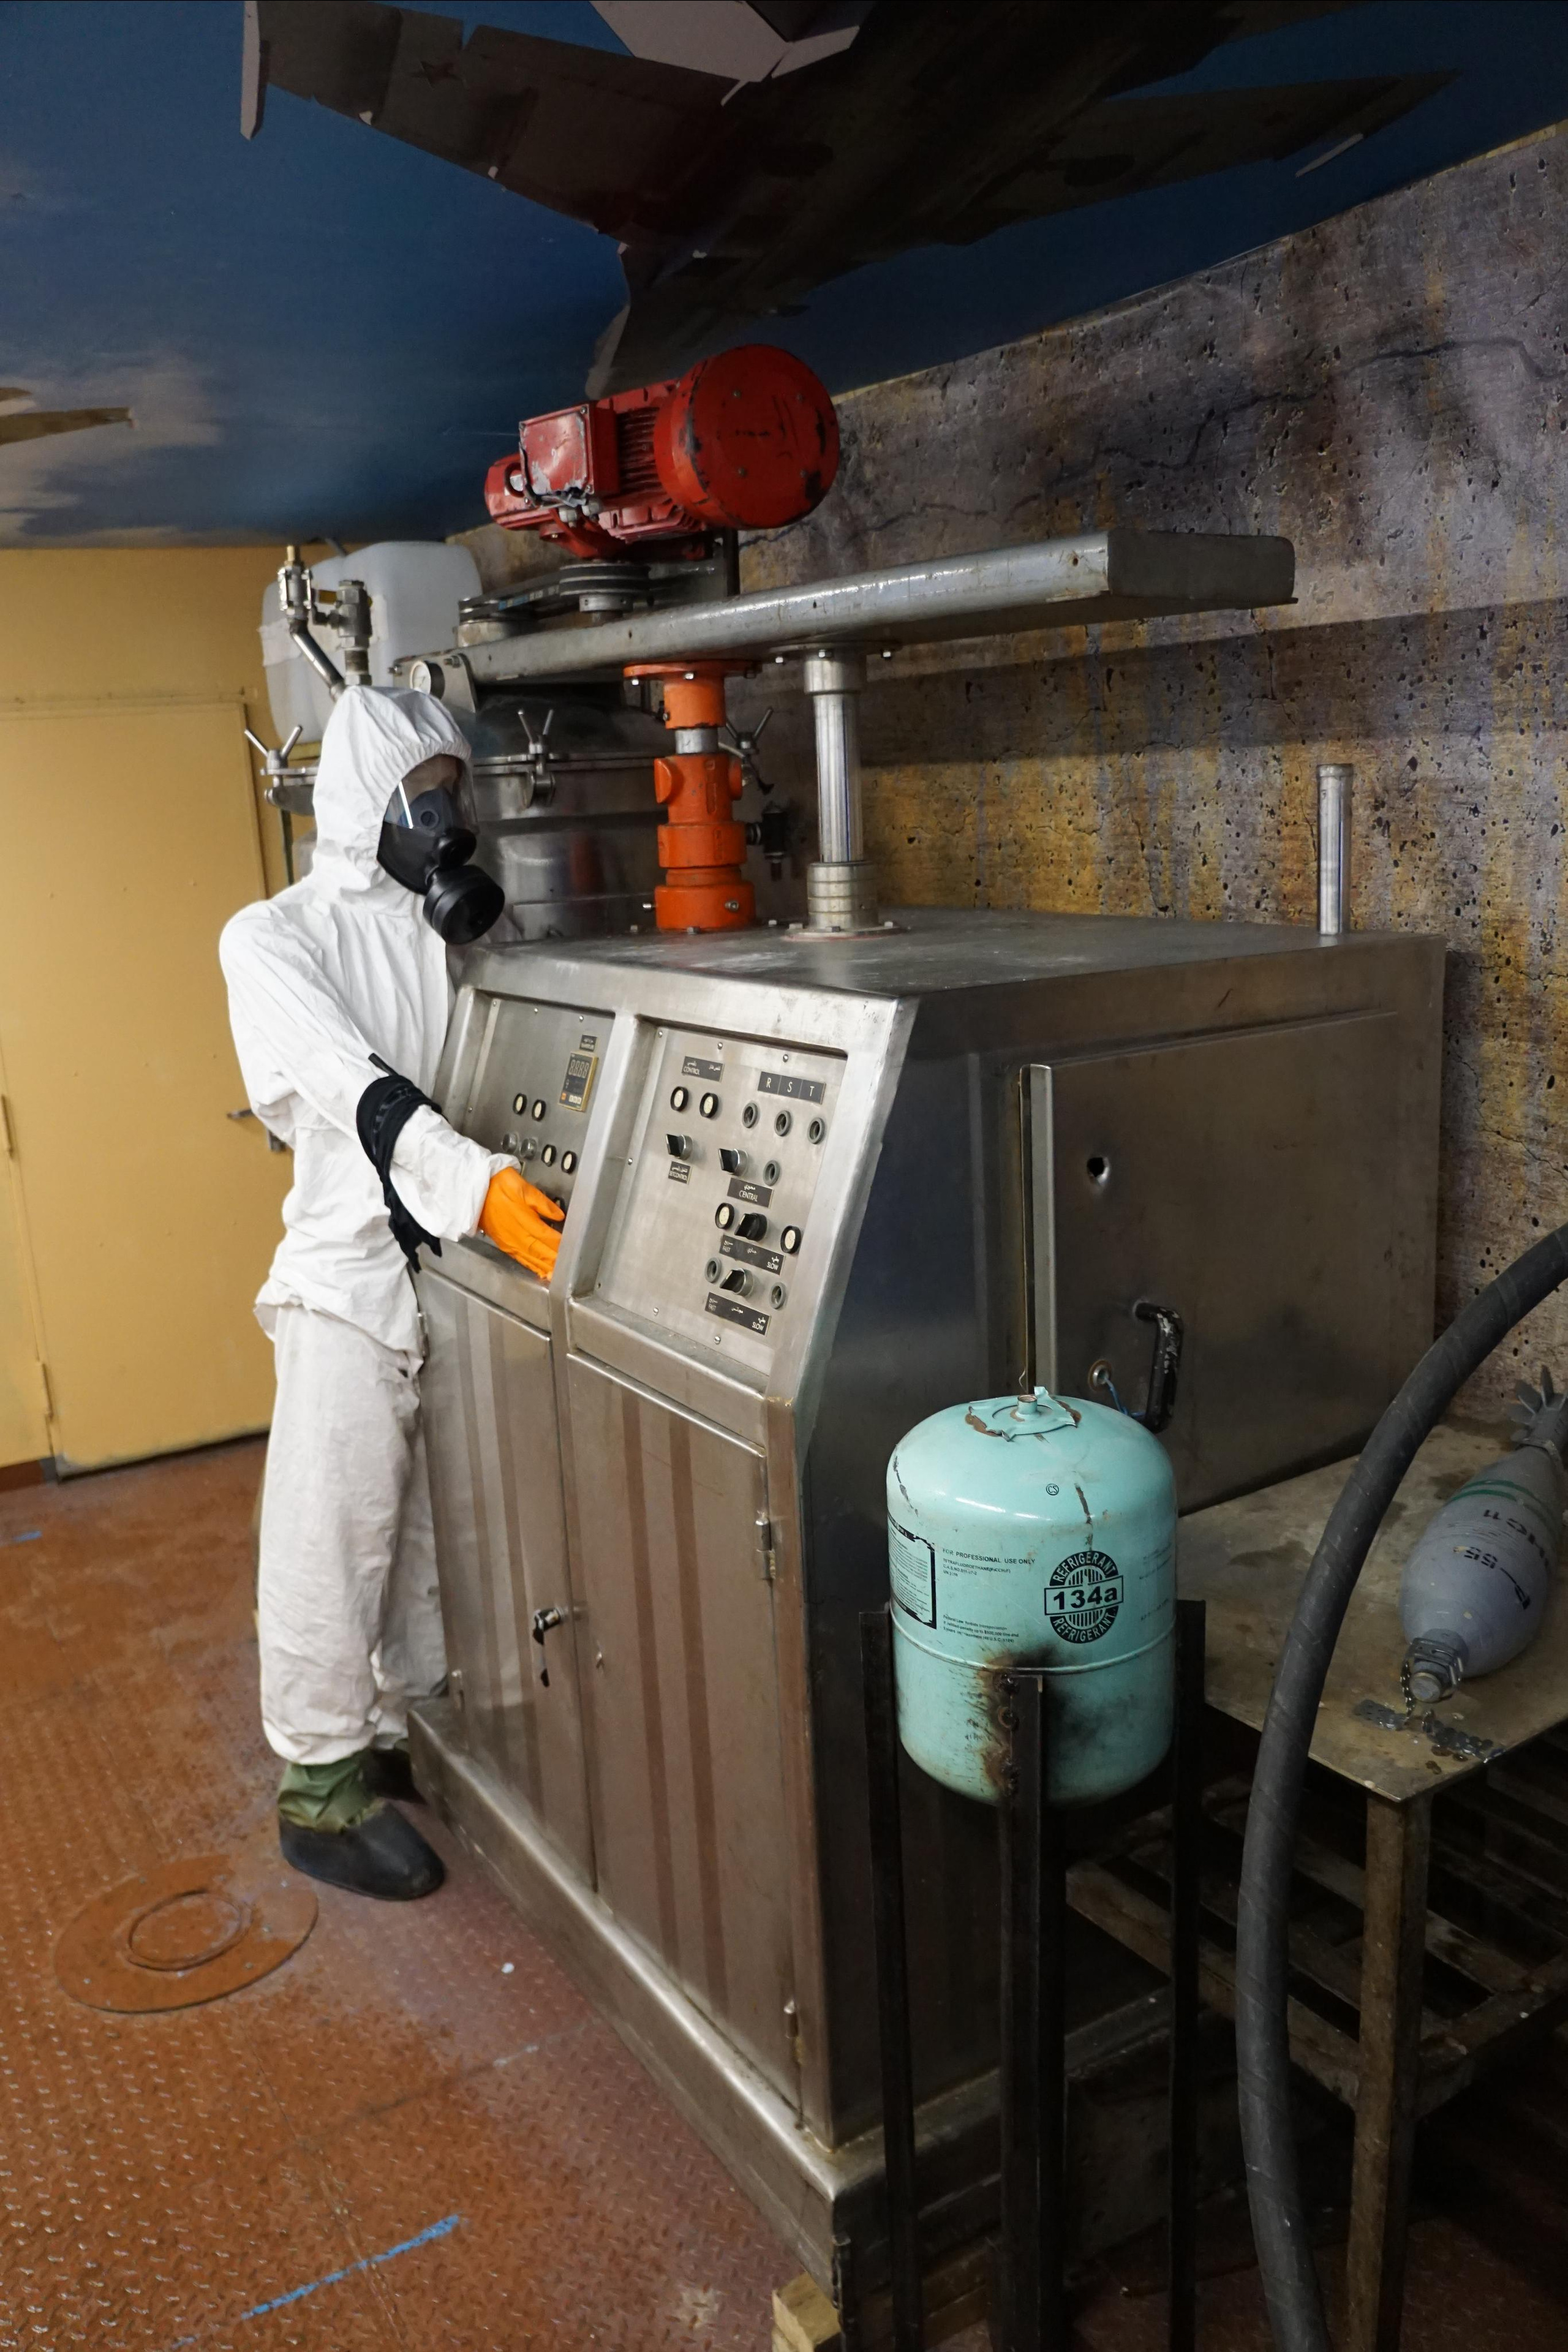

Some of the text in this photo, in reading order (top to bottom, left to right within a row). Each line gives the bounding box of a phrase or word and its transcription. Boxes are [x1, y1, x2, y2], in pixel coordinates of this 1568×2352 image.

[683, 1066, 700, 1075] CONTROL
[766, 1077, 815, 1097] R S T
[739, 1190, 758, 1202] CENTRAL
[766, 1261, 779, 1270] SLOW
[752, 1321, 764, 1331] SLOW
[956, 1551, 1001, 1563] PROFESSIONAL
[1052, 1551, 1116, 1583] REFRIGERANT
[1053, 1585, 1117, 1611] 134a
[1052, 1611, 1116, 1642] REFRIGERANT
